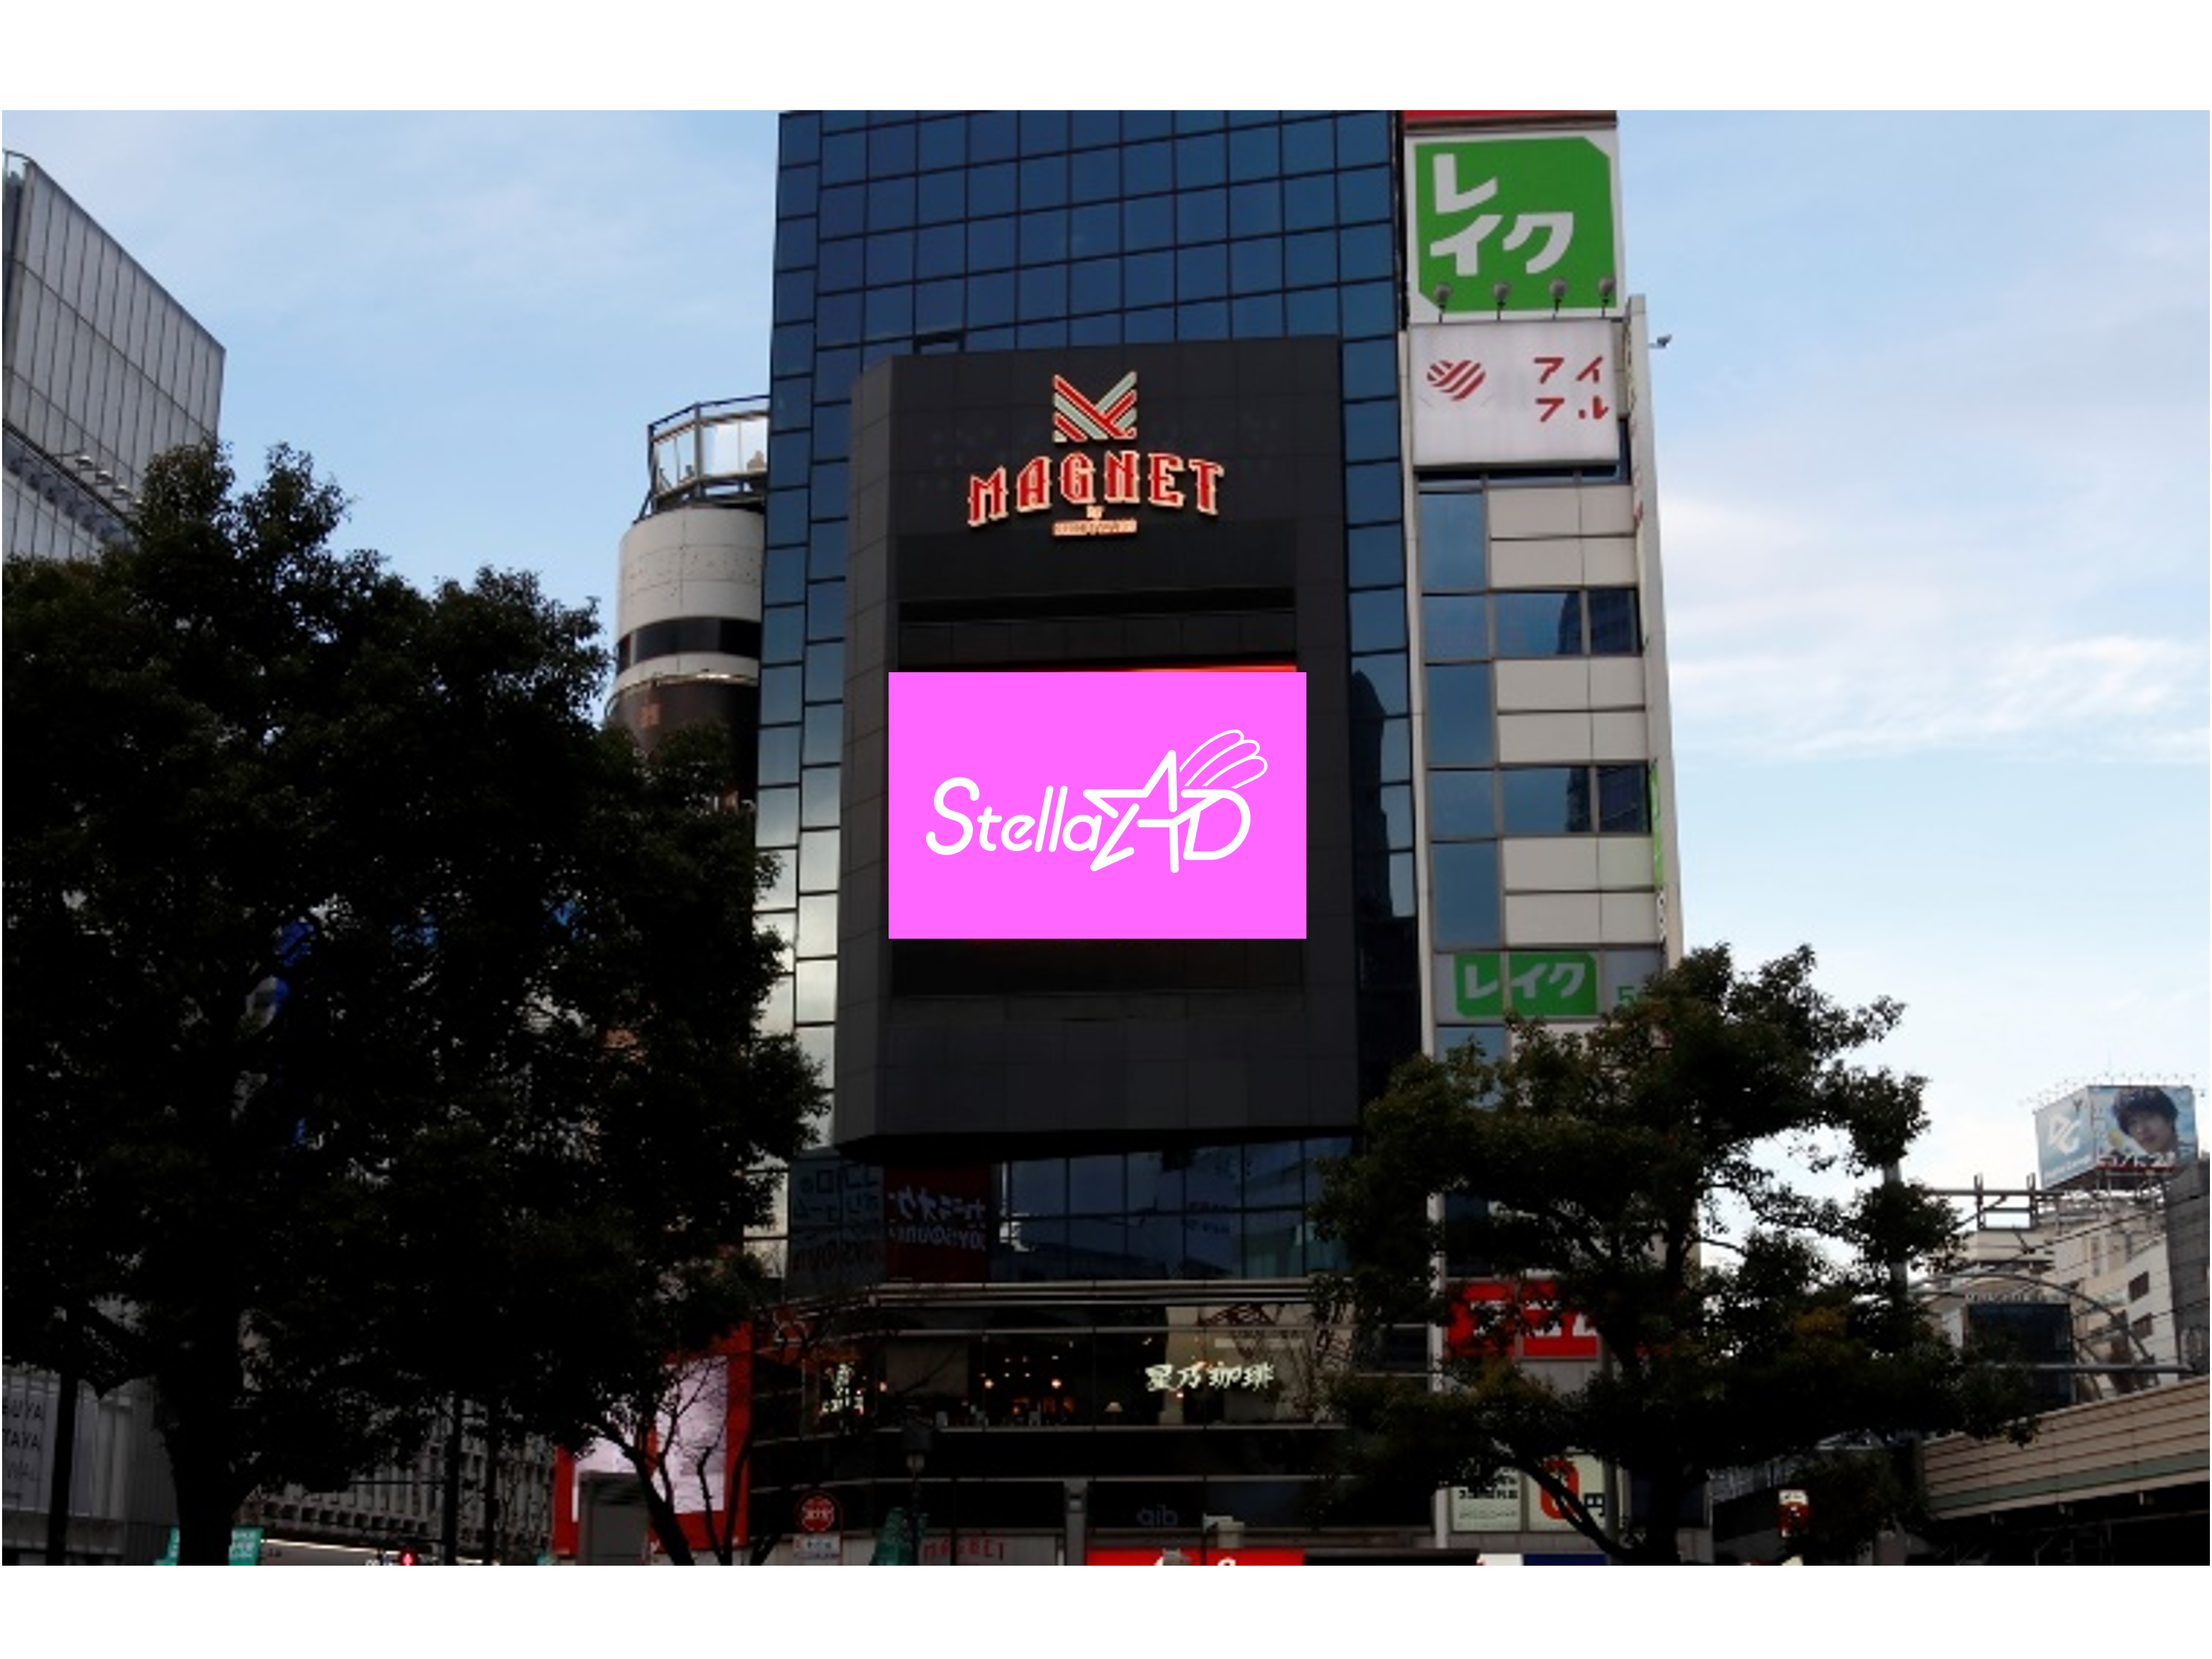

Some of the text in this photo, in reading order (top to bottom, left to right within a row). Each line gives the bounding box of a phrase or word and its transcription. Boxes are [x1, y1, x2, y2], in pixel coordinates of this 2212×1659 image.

[1429, 212, 1574, 276] イク
[1534, 356, 1604, 384] アイ
[1535, 396, 1609, 422] フル
[967, 450, 1224, 527] MAGNET
[1463, 962, 1586, 999] レイク
